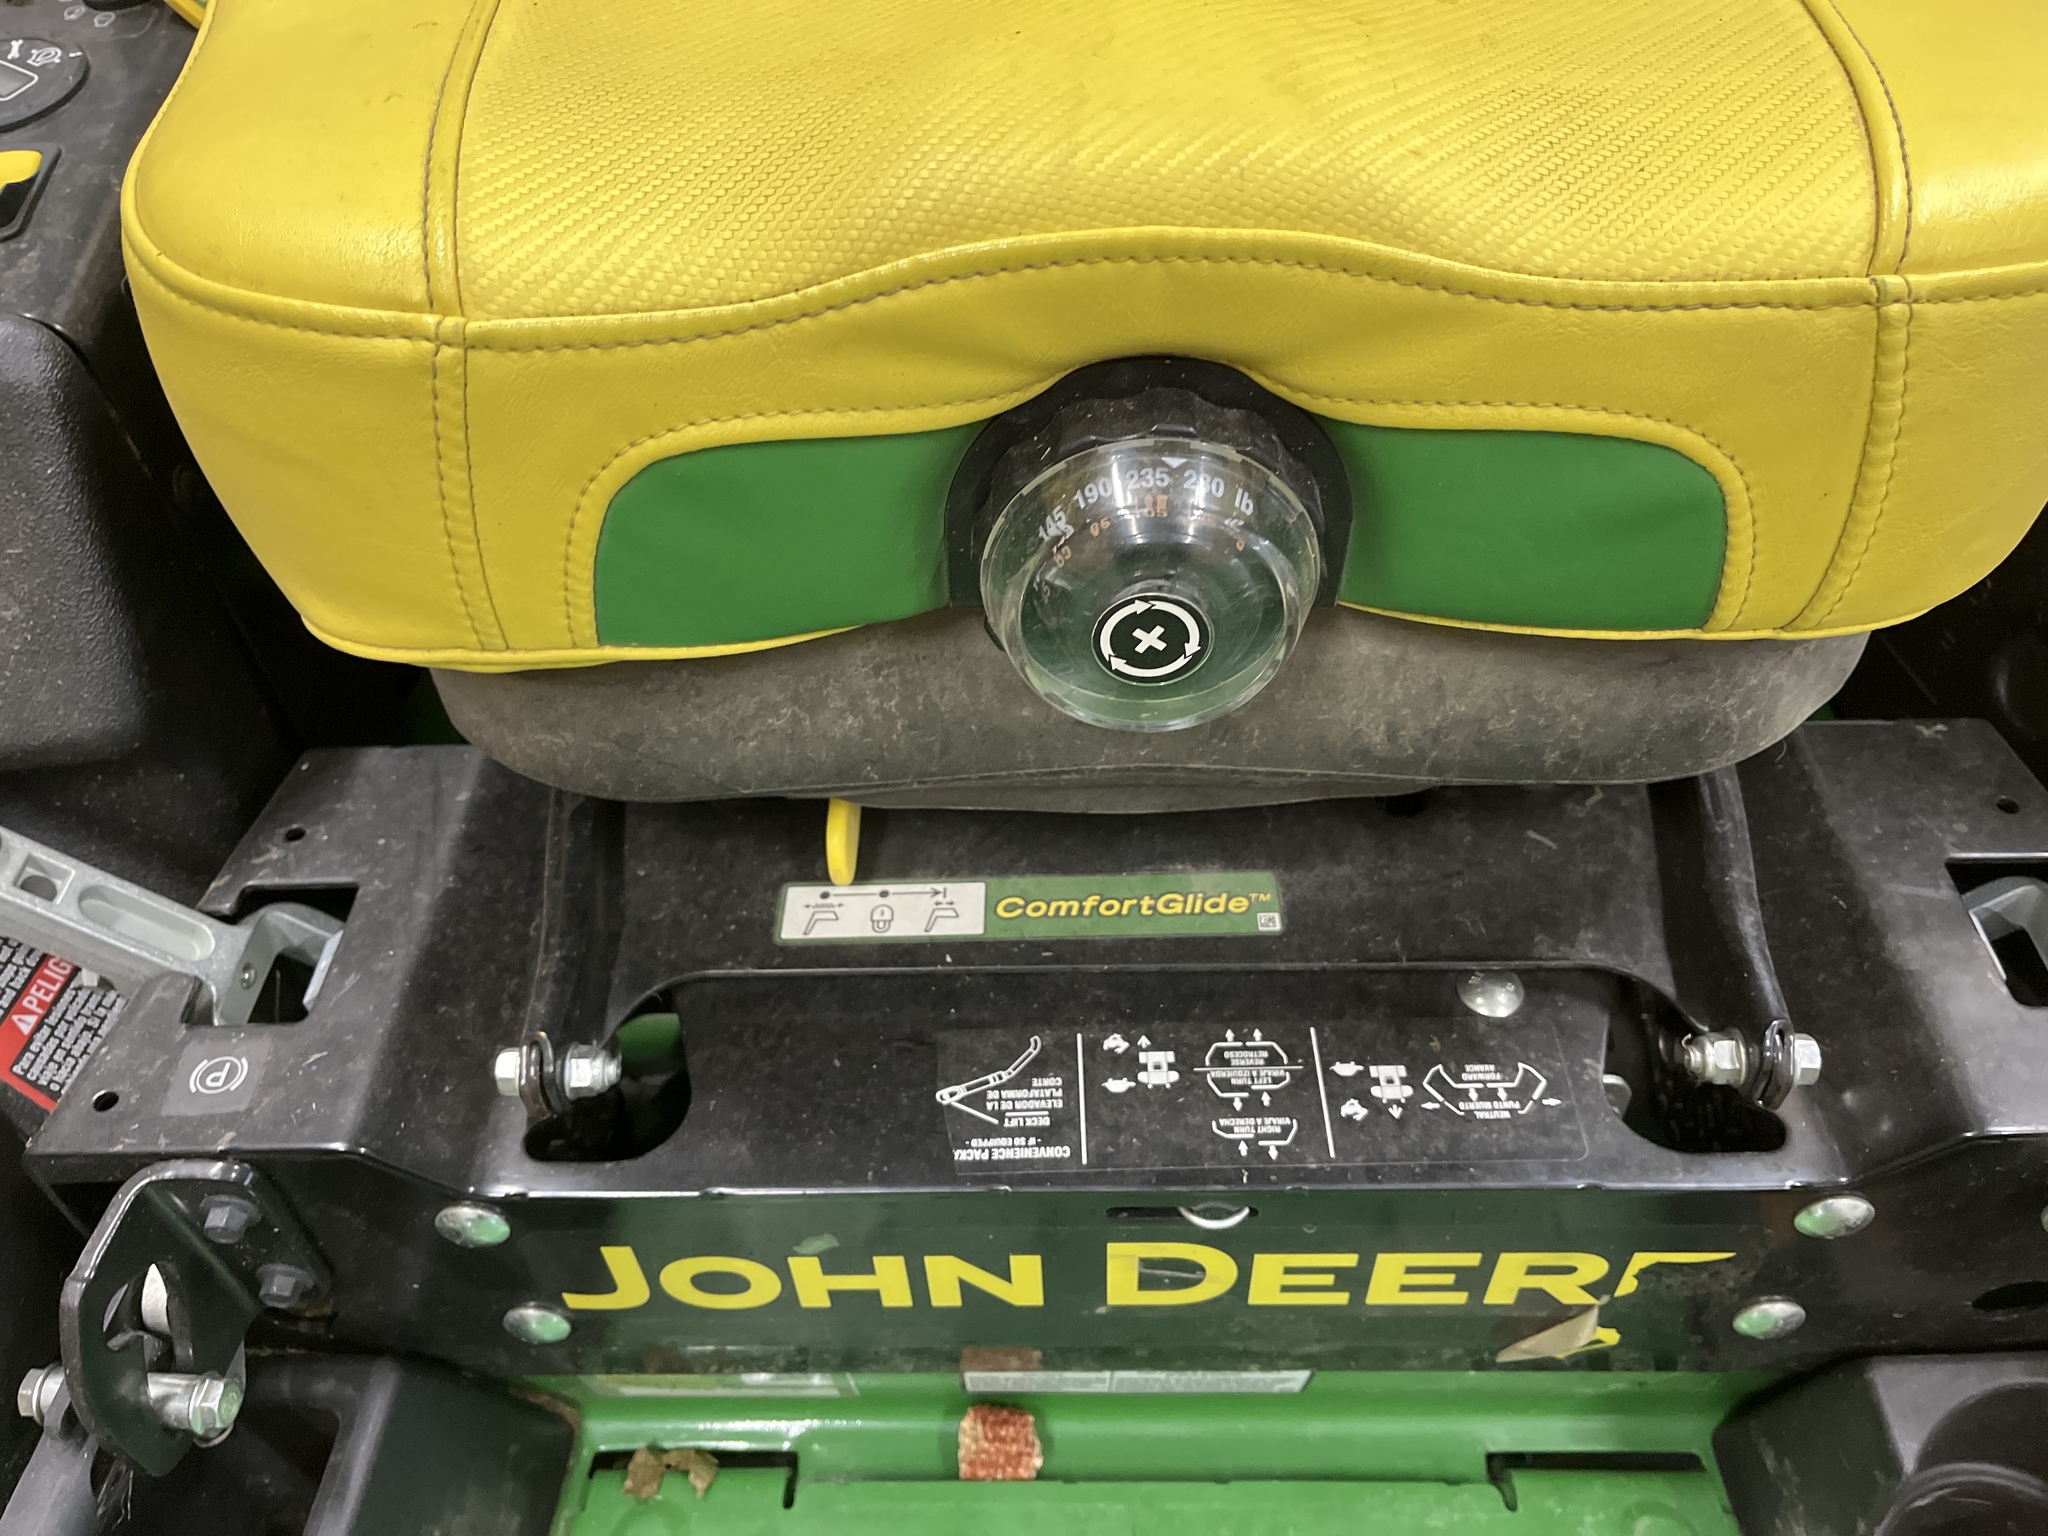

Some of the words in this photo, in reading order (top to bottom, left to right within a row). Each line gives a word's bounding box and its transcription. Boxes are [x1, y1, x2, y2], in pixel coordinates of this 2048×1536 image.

[1074, 477, 1113, 509] 190
[1125, 468, 1170, 489] 235
[1234, 488, 1254, 515] lb
[1004, 1118, 1024, 1127] LIFT
[1025, 1117, 1050, 1126] DECK
[991, 1146, 1070, 1159] CONVENIENCE
[562, 1246, 1044, 1310] JOHN
